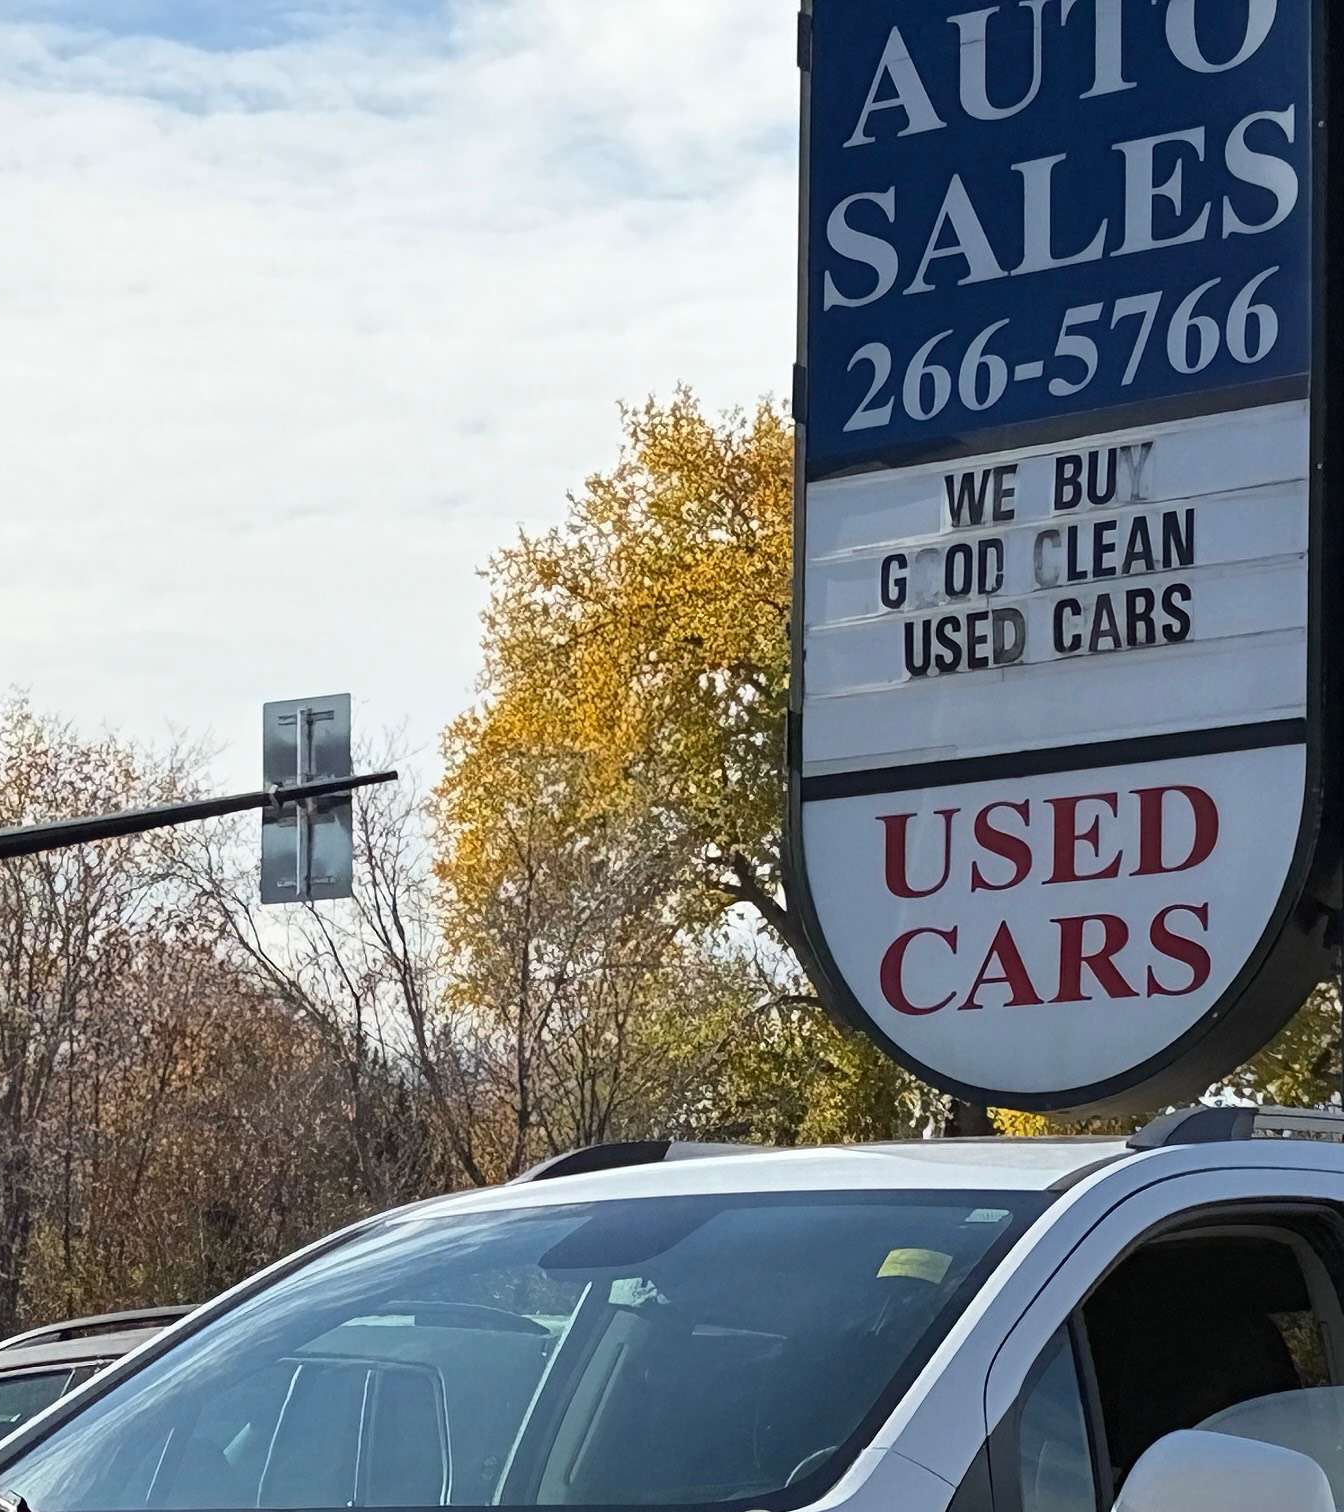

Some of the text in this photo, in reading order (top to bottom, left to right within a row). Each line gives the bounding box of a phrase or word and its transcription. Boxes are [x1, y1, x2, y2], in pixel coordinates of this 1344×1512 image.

[842, 0, 1278, 149] AUTO
[823, 104, 1299, 311] SALES
[843, 265, 1280, 432] 266-5766
[944, 441, 1154, 528] WE BUY
[880, 507, 1195, 609] GOD CLEAN
[903, 582, 1193, 677] USED CARS
[874, 783, 1220, 899] USED
[878, 901, 1212, 1017] CARS
